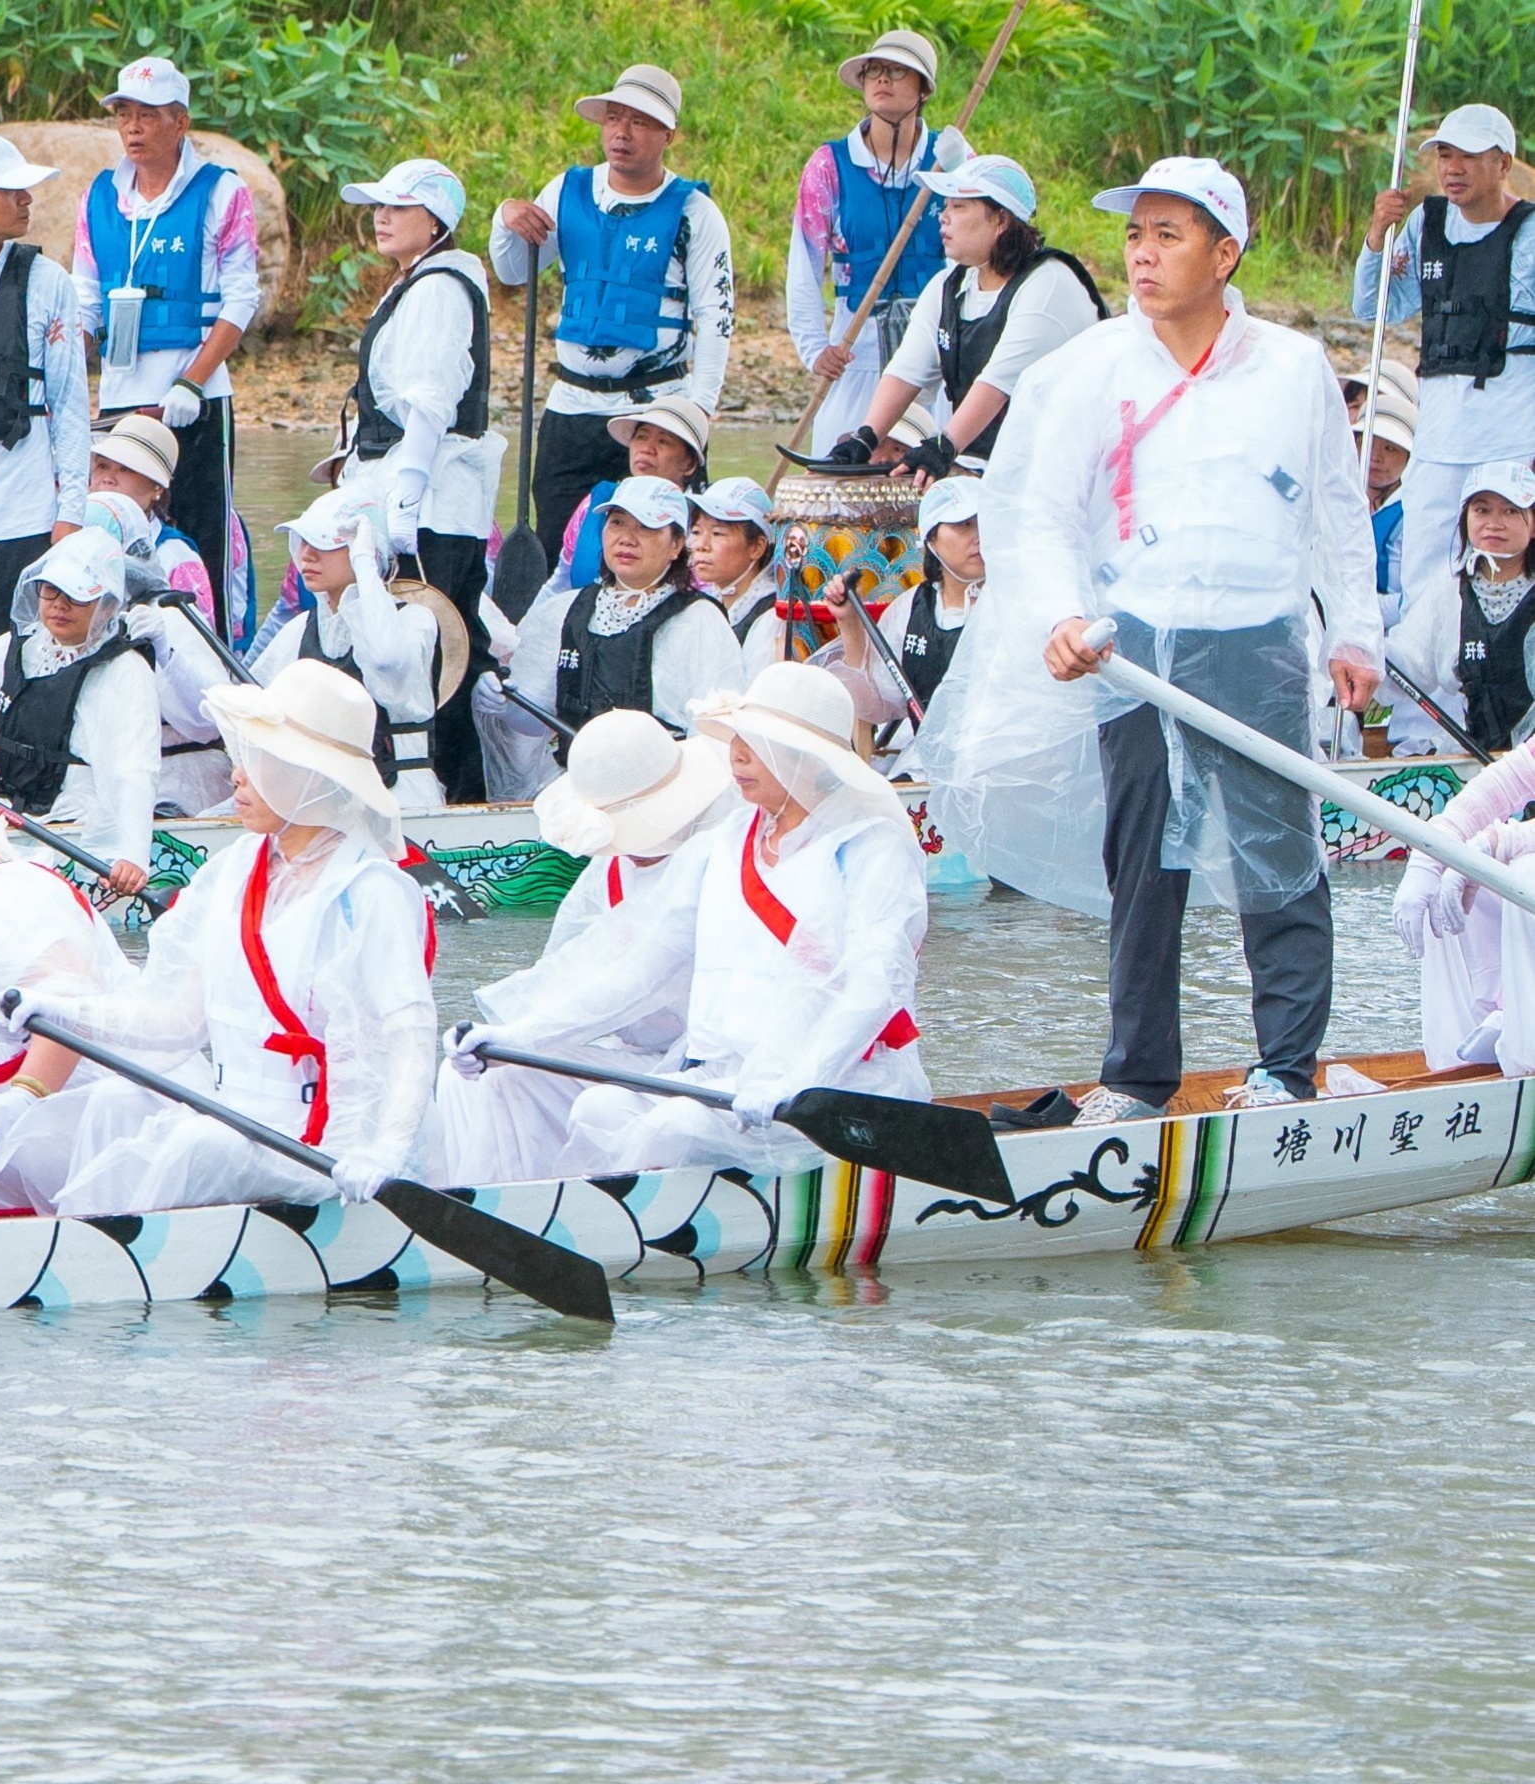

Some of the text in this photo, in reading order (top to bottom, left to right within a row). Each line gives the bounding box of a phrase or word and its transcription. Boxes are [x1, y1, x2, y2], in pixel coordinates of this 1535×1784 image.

[151, 236, 185, 254] 河头
[625, 234, 658, 253] 河头
[1273, 1101, 1482, 1167] 塘川聖祖
